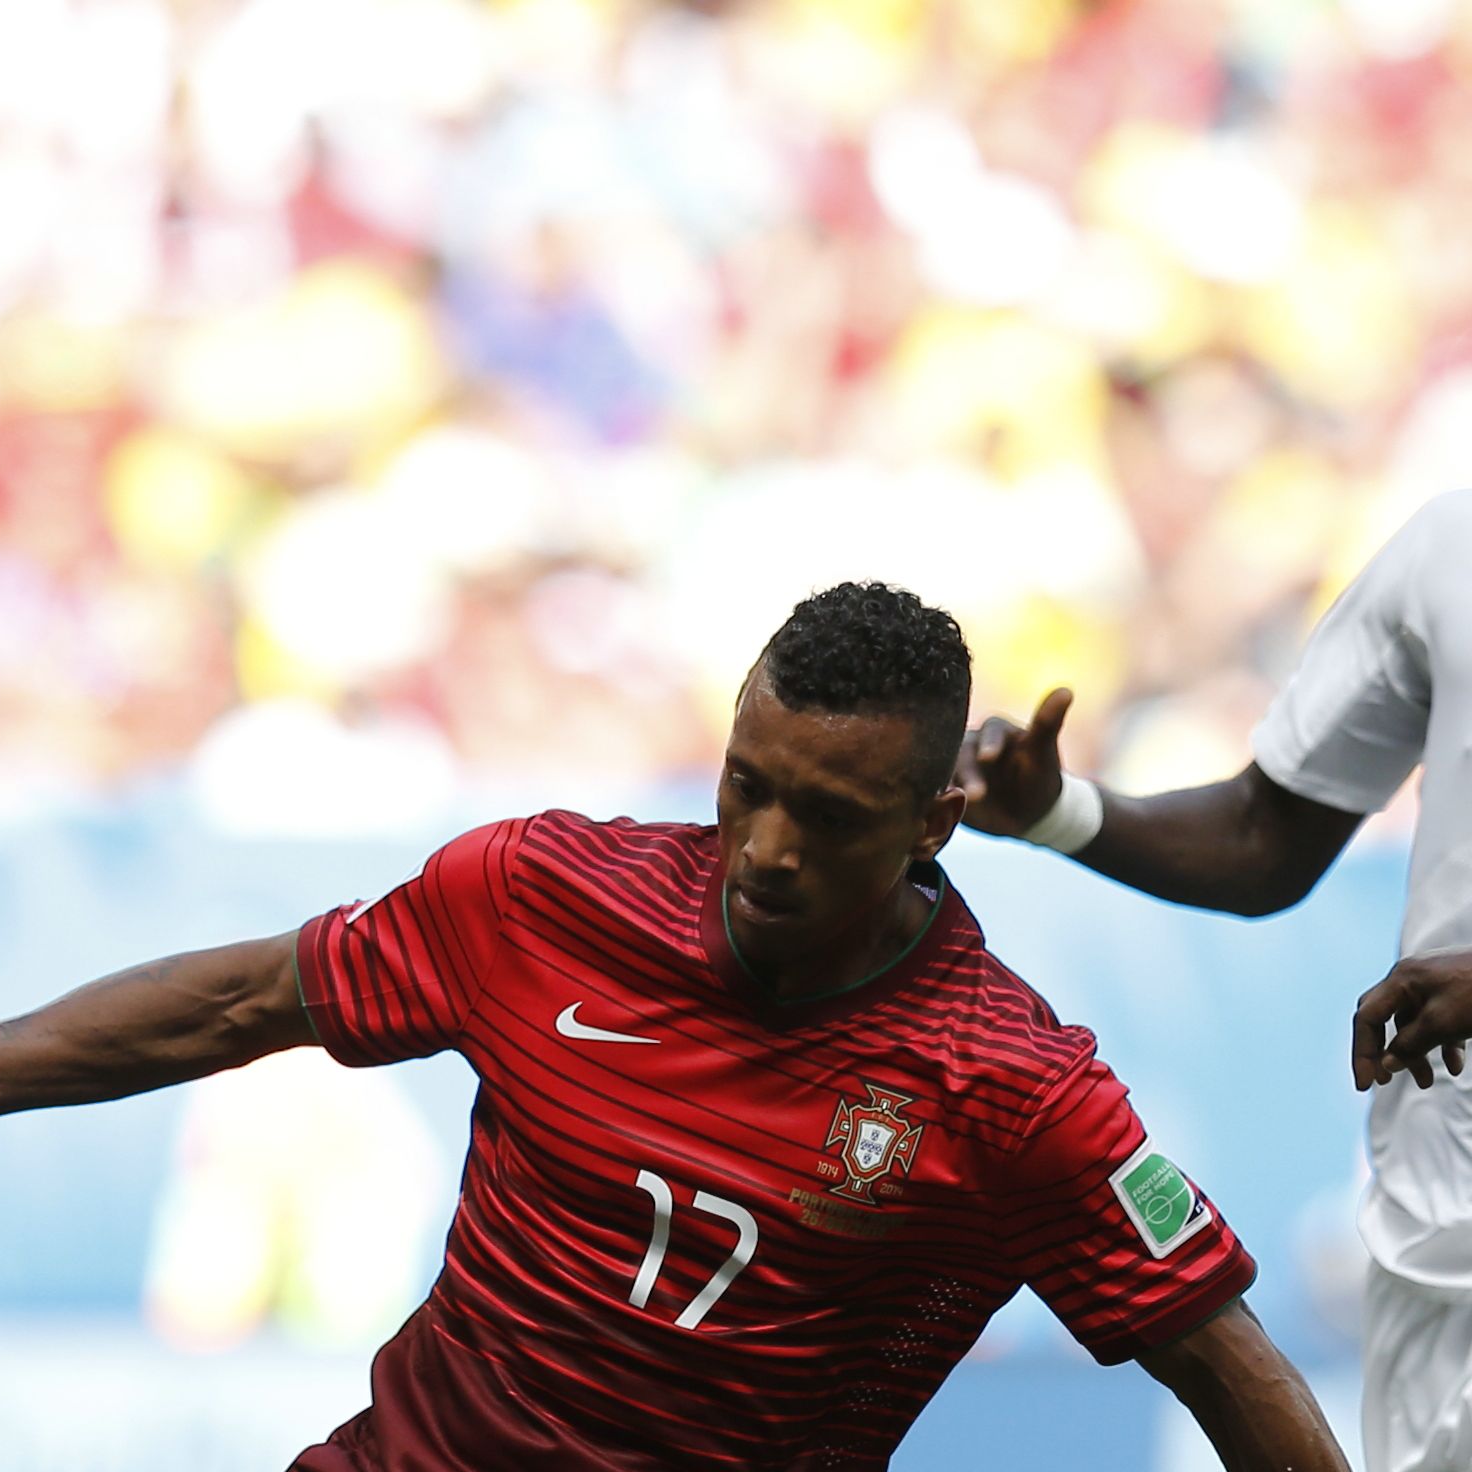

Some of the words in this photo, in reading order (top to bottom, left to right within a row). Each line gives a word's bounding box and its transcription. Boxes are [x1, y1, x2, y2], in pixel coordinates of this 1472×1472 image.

[817, 1161, 839, 1178] 1914
[1132, 1162, 1171, 1198] FOOTBALL
[1136, 1188, 1154, 1205] FOR
[1154, 1169, 1175, 1191] HOPE
[879, 1183, 904, 1197] 2014
[628, 1169, 759, 1330] 17
